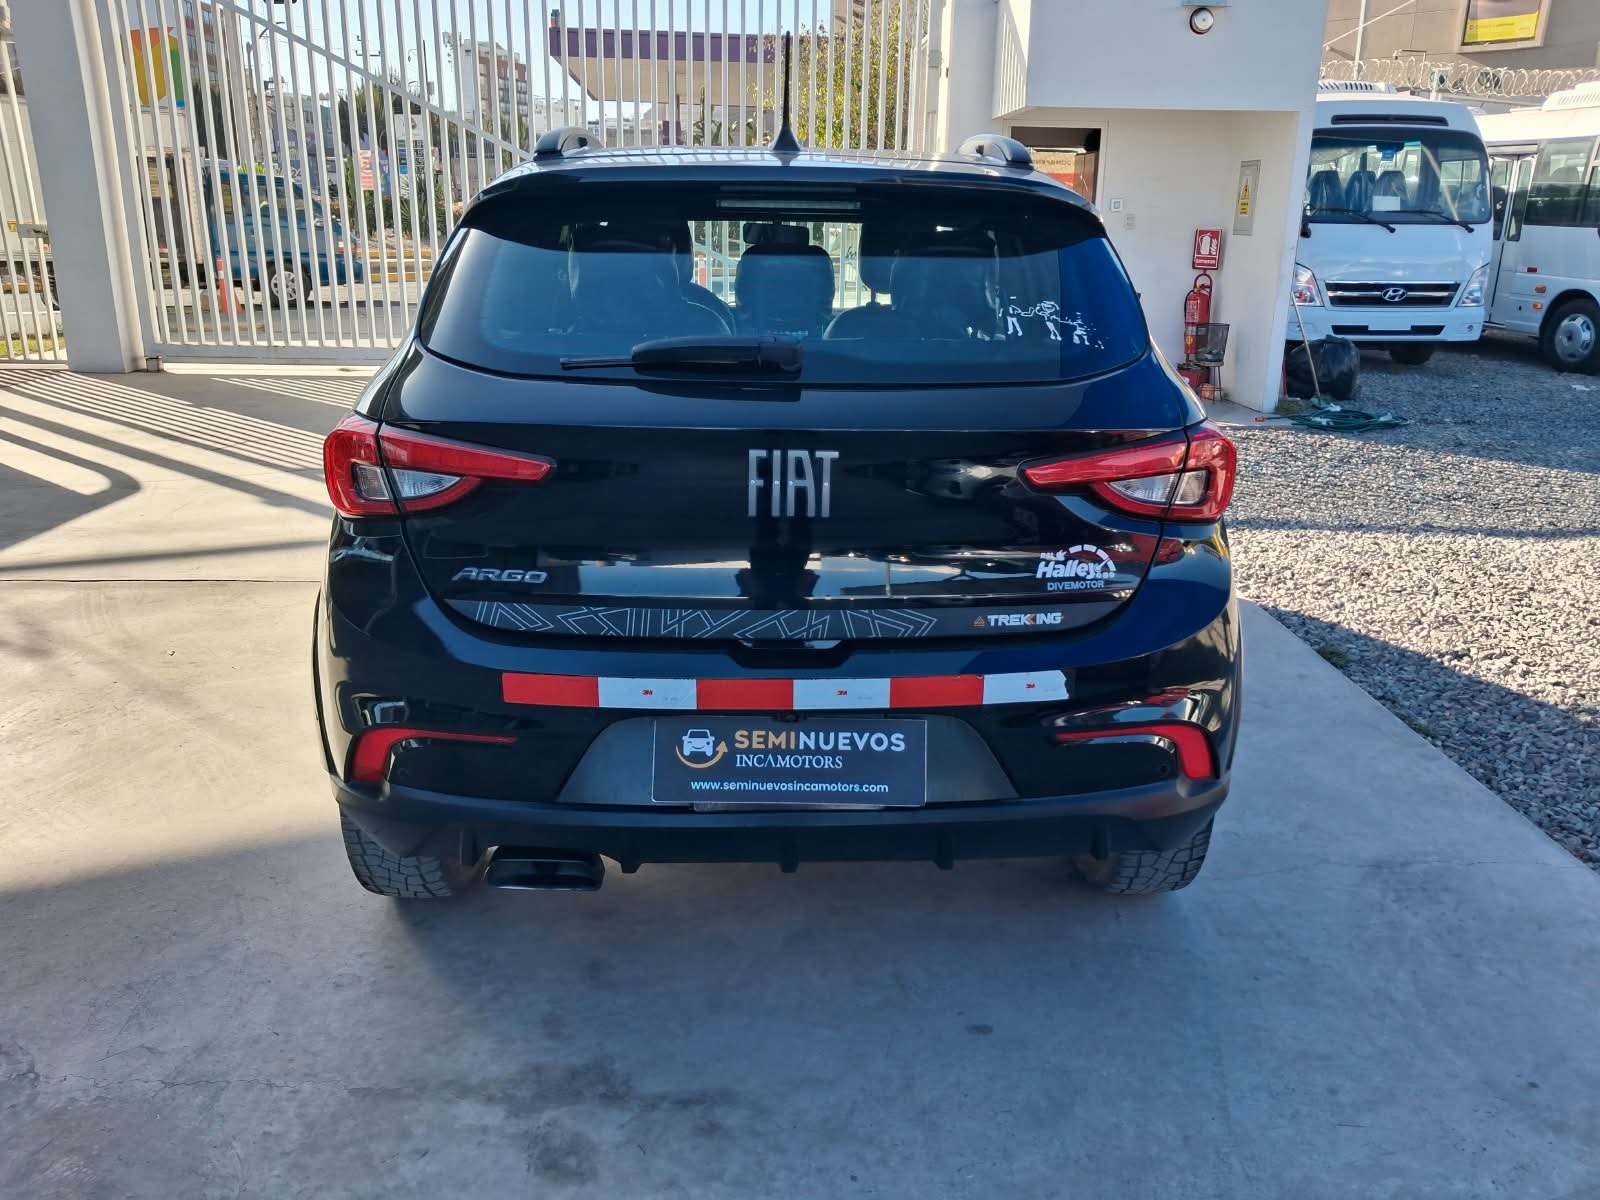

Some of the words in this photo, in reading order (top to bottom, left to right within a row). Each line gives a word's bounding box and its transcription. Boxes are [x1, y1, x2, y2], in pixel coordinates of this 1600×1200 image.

[748, 448, 840, 518] FIAT
[452, 566, 547, 583] ARGO
[1047, 580, 1104, 591] DIVEMOTOR
[734, 730, 906, 752] SEMINUEVOS
[735, 754, 843, 769] INCAMOTORS
[690, 779, 889, 793] www.seminuevosincamotors.com
